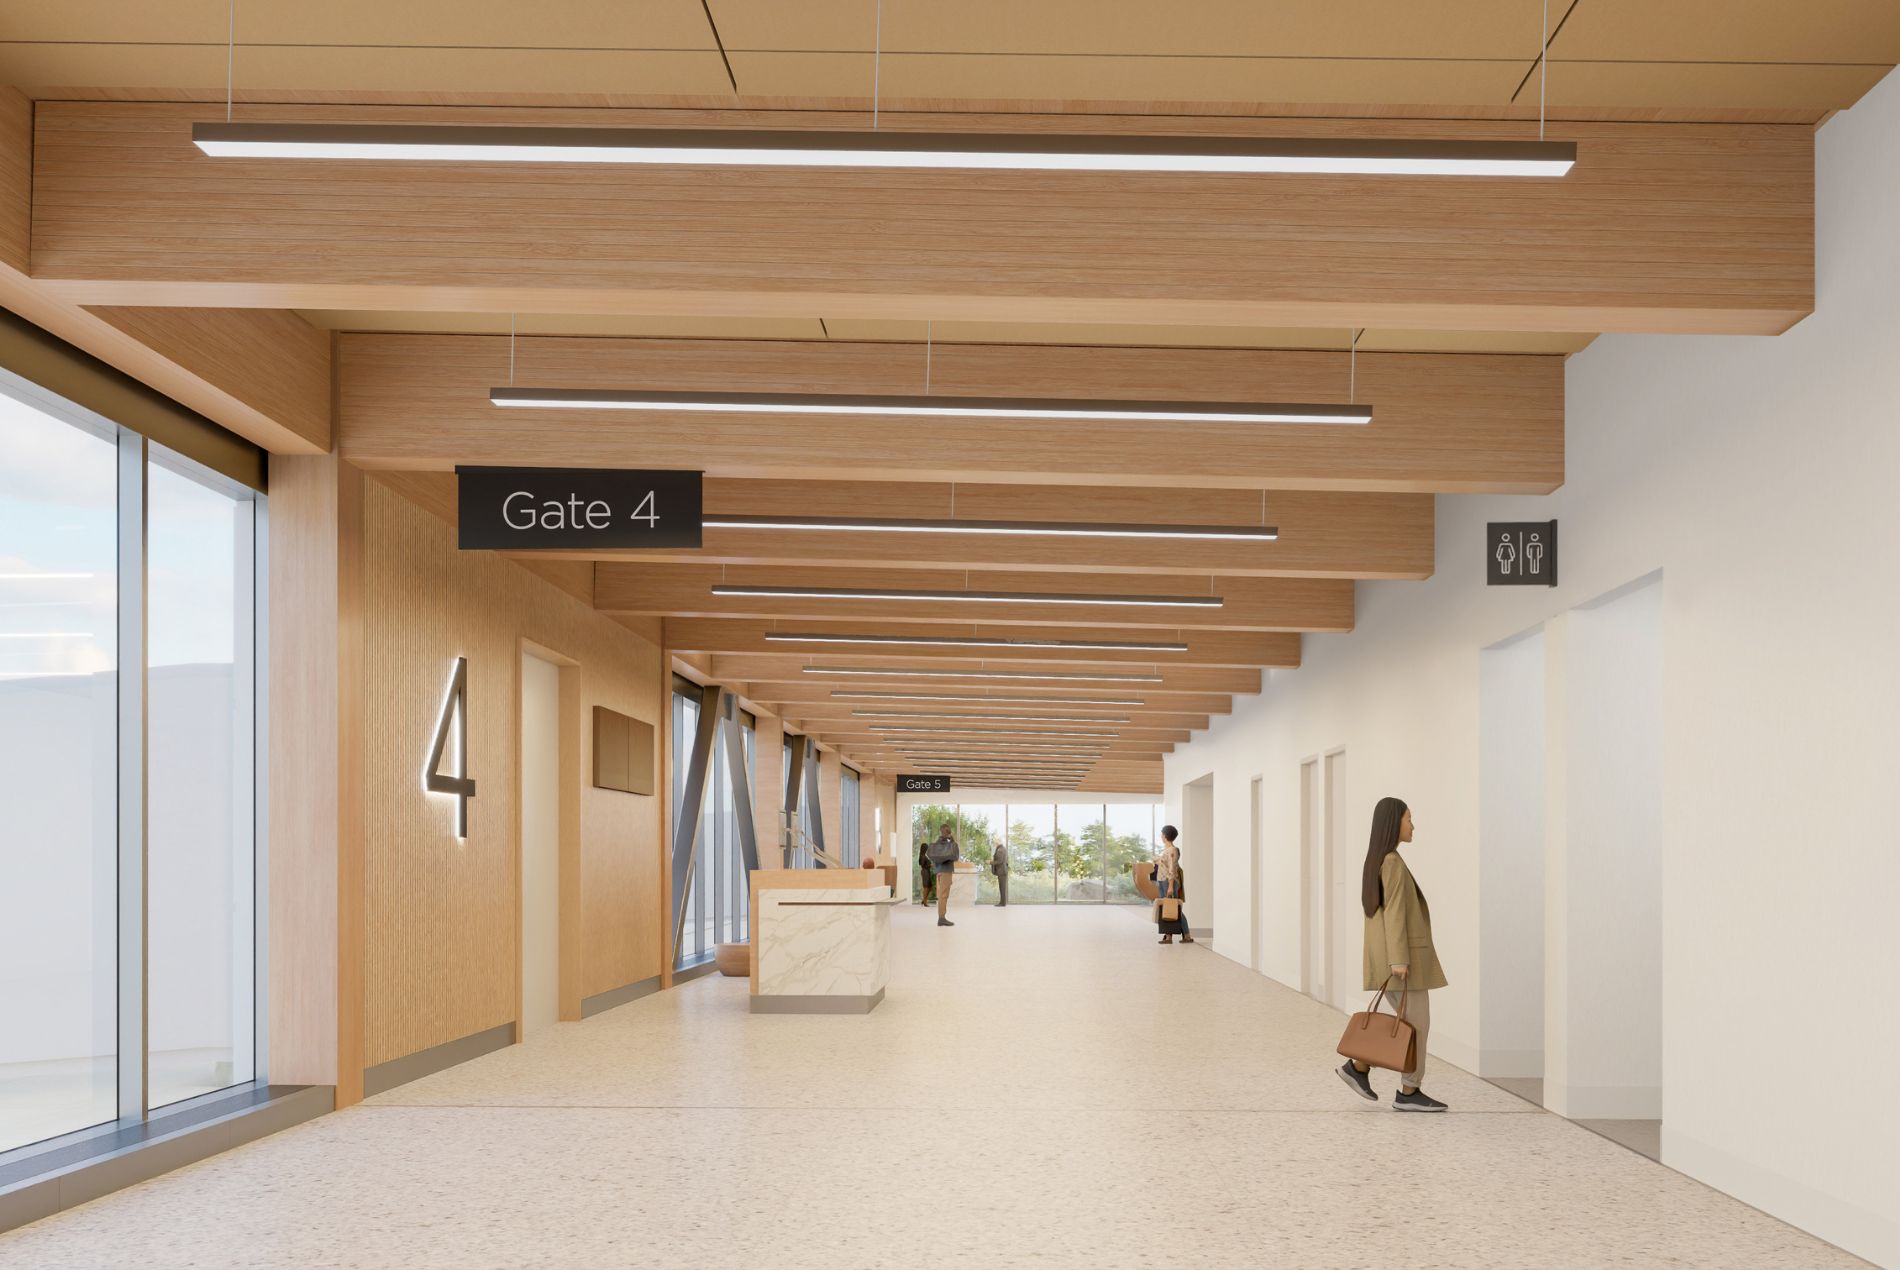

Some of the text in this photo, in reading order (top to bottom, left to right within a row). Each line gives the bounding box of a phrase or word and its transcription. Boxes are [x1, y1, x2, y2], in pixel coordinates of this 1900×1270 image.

[502, 490, 660, 530] Gate 4
[424, 656, 476, 839] 4
[906, 779, 941, 789] Gate 5
